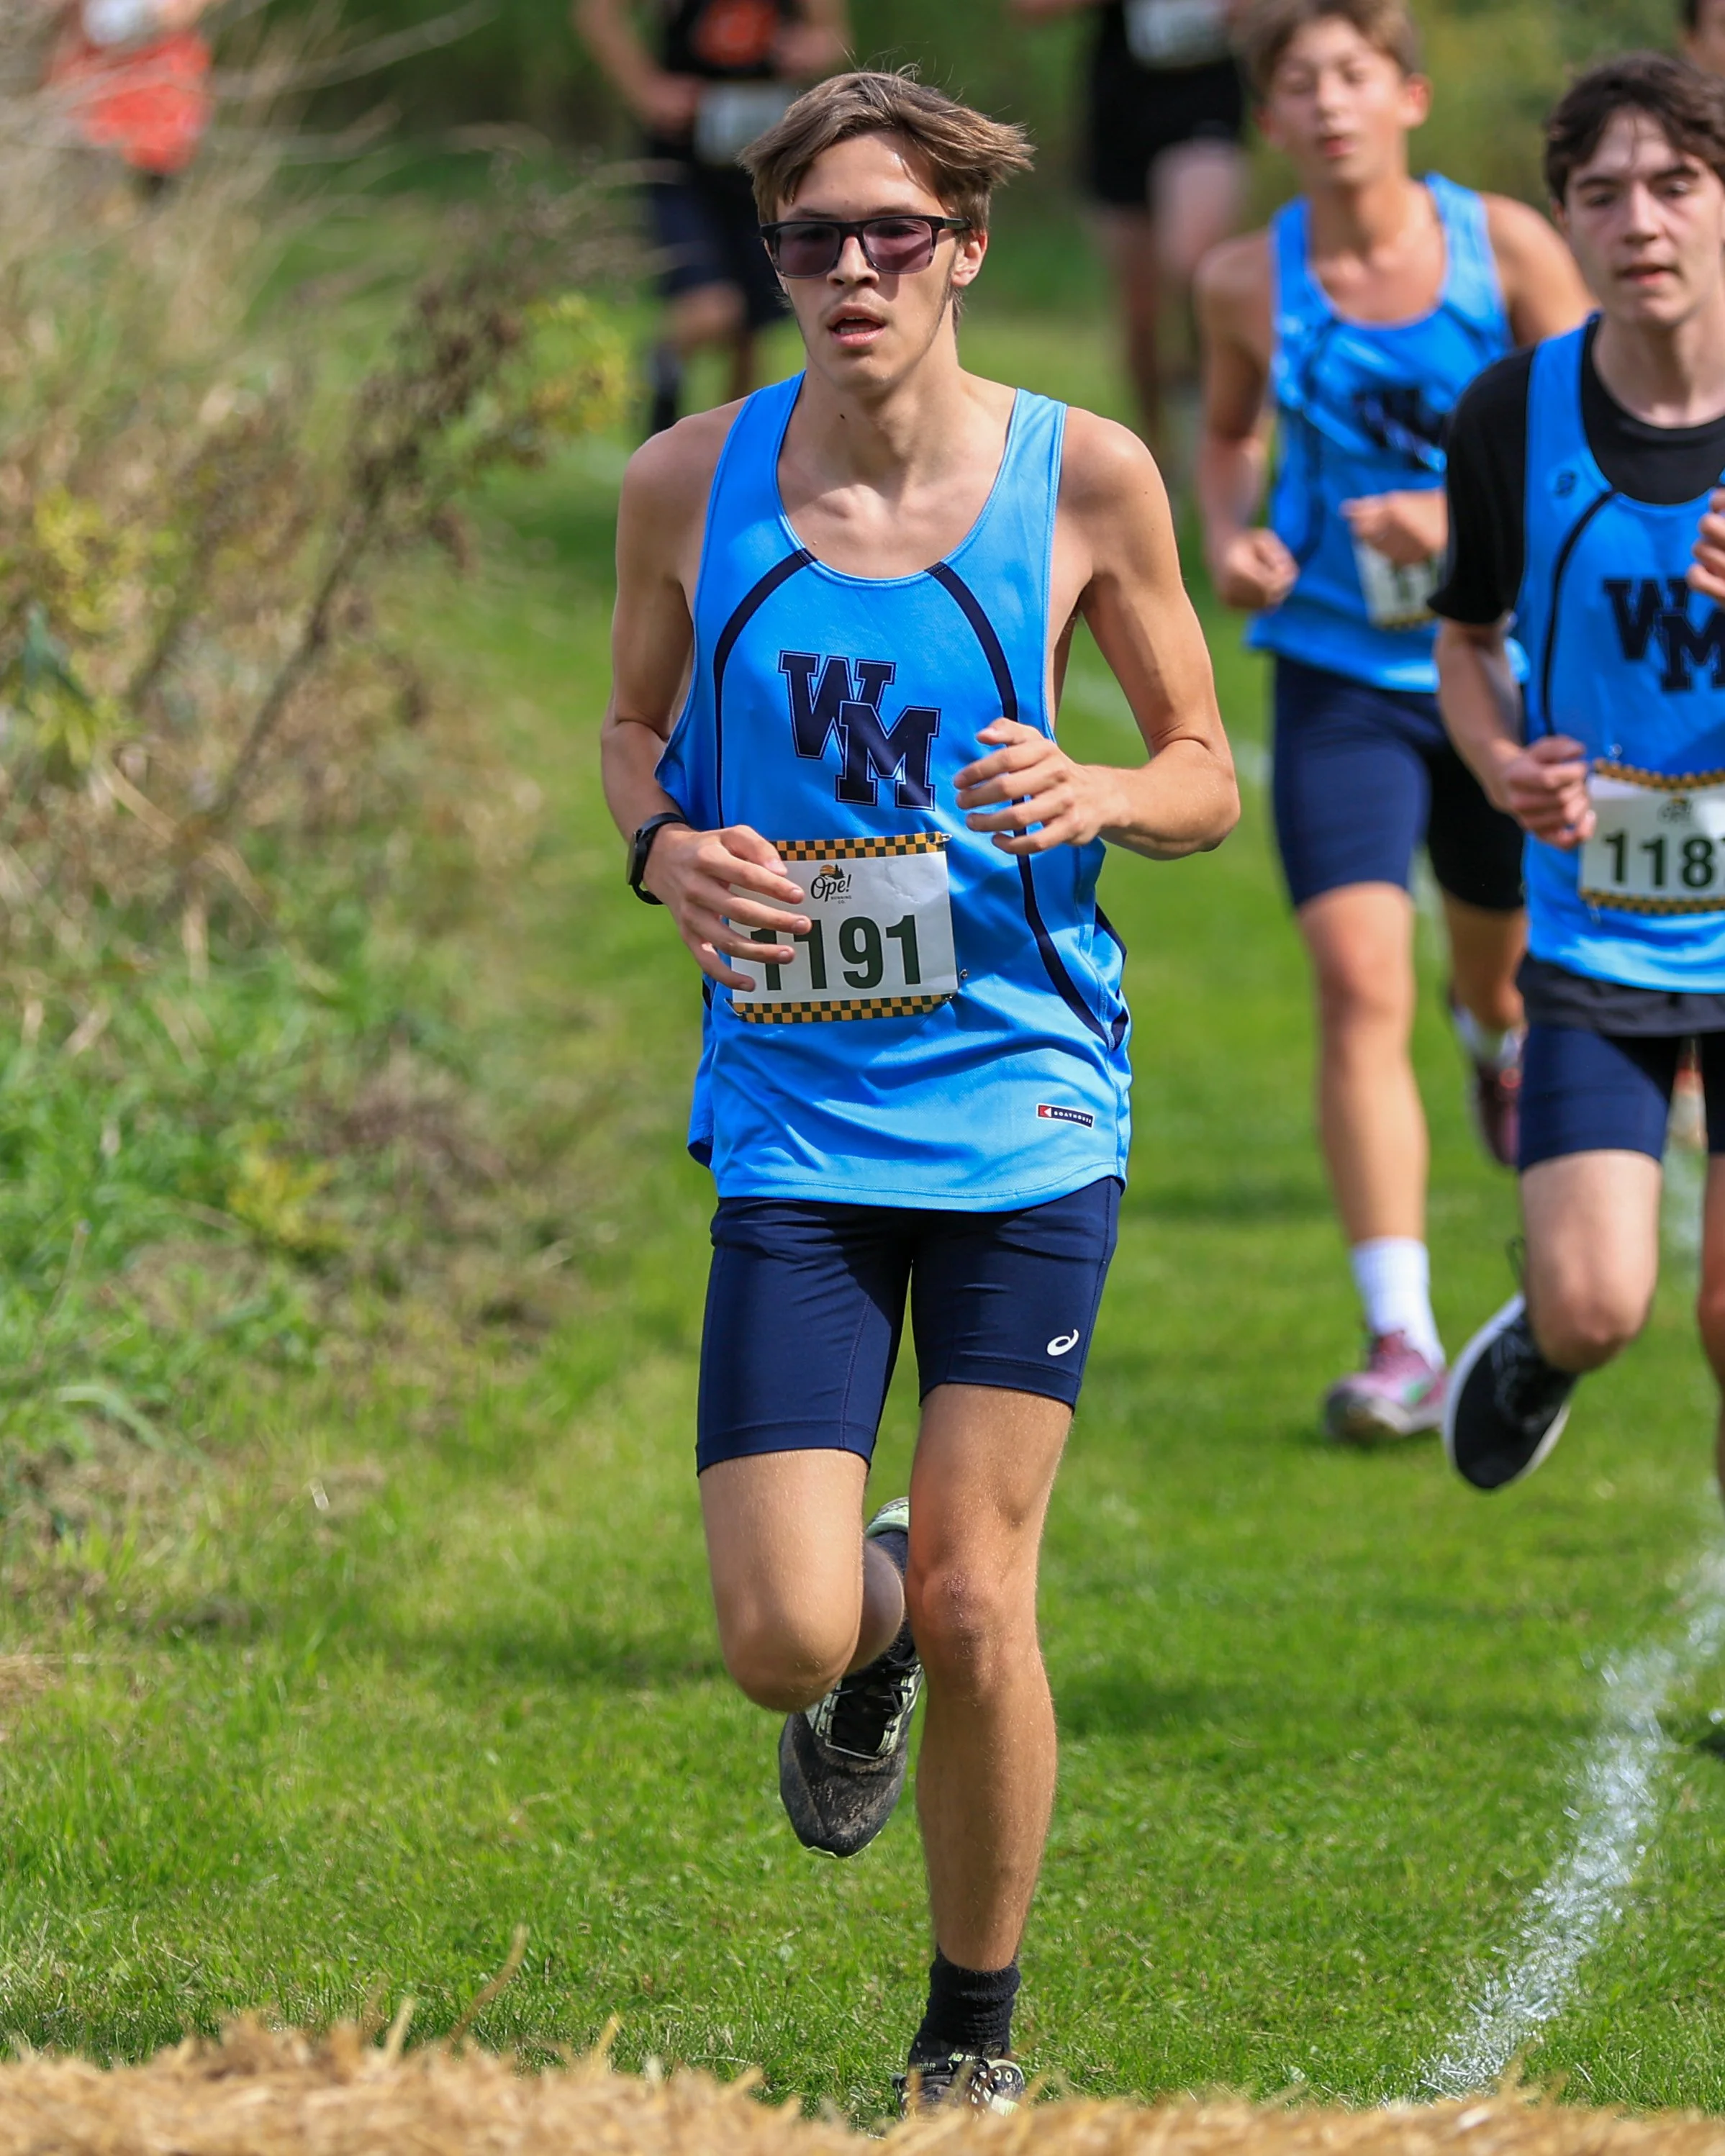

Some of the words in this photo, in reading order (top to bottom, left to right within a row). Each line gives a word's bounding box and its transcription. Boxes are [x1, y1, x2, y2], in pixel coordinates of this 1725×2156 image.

[1604, 579, 1725, 693] WM
[778, 650, 941, 811] WM
[810, 874, 851, 902] Ope!
[1603, 830, 1725, 889] 118
[751, 915, 921, 991] 1191
[1054, 1110, 1092, 1123] BOATHOUSE
